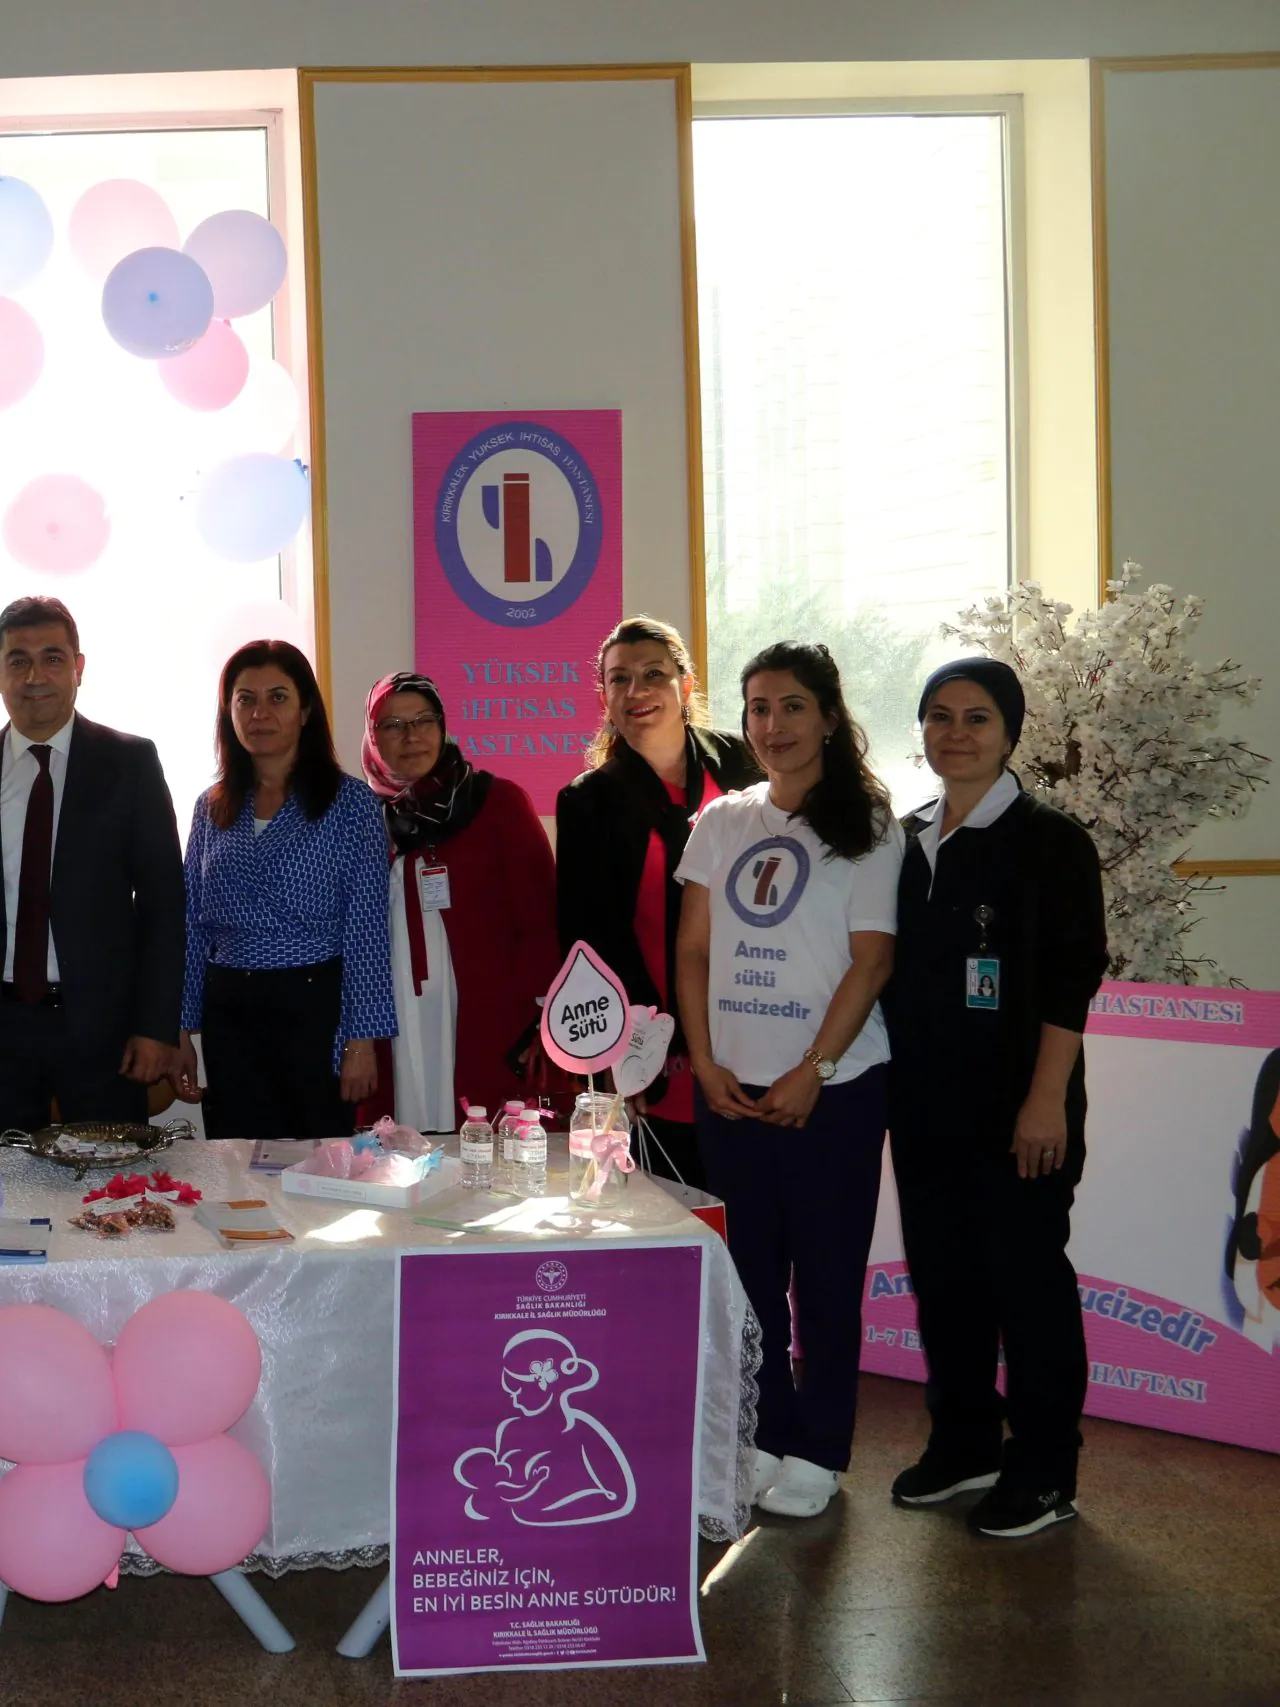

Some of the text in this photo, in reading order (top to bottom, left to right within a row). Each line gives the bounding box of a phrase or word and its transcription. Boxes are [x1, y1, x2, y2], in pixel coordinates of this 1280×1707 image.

[505, 607, 537, 619] 2002
[461, 658, 581, 685] YÜKSEK
[734, 940, 787, 961] Anne
[734, 969, 776, 988] sütü
[561, 996, 610, 1025] Anne
[718, 998, 811, 1020] mucizedir
[568, 1013, 608, 1043] Sütü
[516, 1294, 542, 1303] TÜRKİYE
[516, 1300, 586, 1310] SAĞLIK BAKANLIĞI
[494, 1308, 607, 1320] KIRIKKALE İL SAĞLIK MÜDÜRLÜĞÜ
[869, 1269, 1218, 1355] An ucizedir
[866, 1325, 896, 1346] 1-7
[1090, 1361, 1207, 1403] HAFTASI
[412, 1548, 504, 1566] ANNELER,
[412, 1567, 555, 1589] BEBEĞİNİZ İÇİN,
[413, 1585, 676, 1612] EN İYİ BESİN ANNE SÜTÜDÜR!
[522, 1620, 545, 1628] SAĞLIK
[545, 1619, 580, 1627] BAKANLIĞI
[533, 1628, 555, 1637] SAĞLIK
[556, 1626, 598, 1636] MÜDÜRLÜĞÜ
